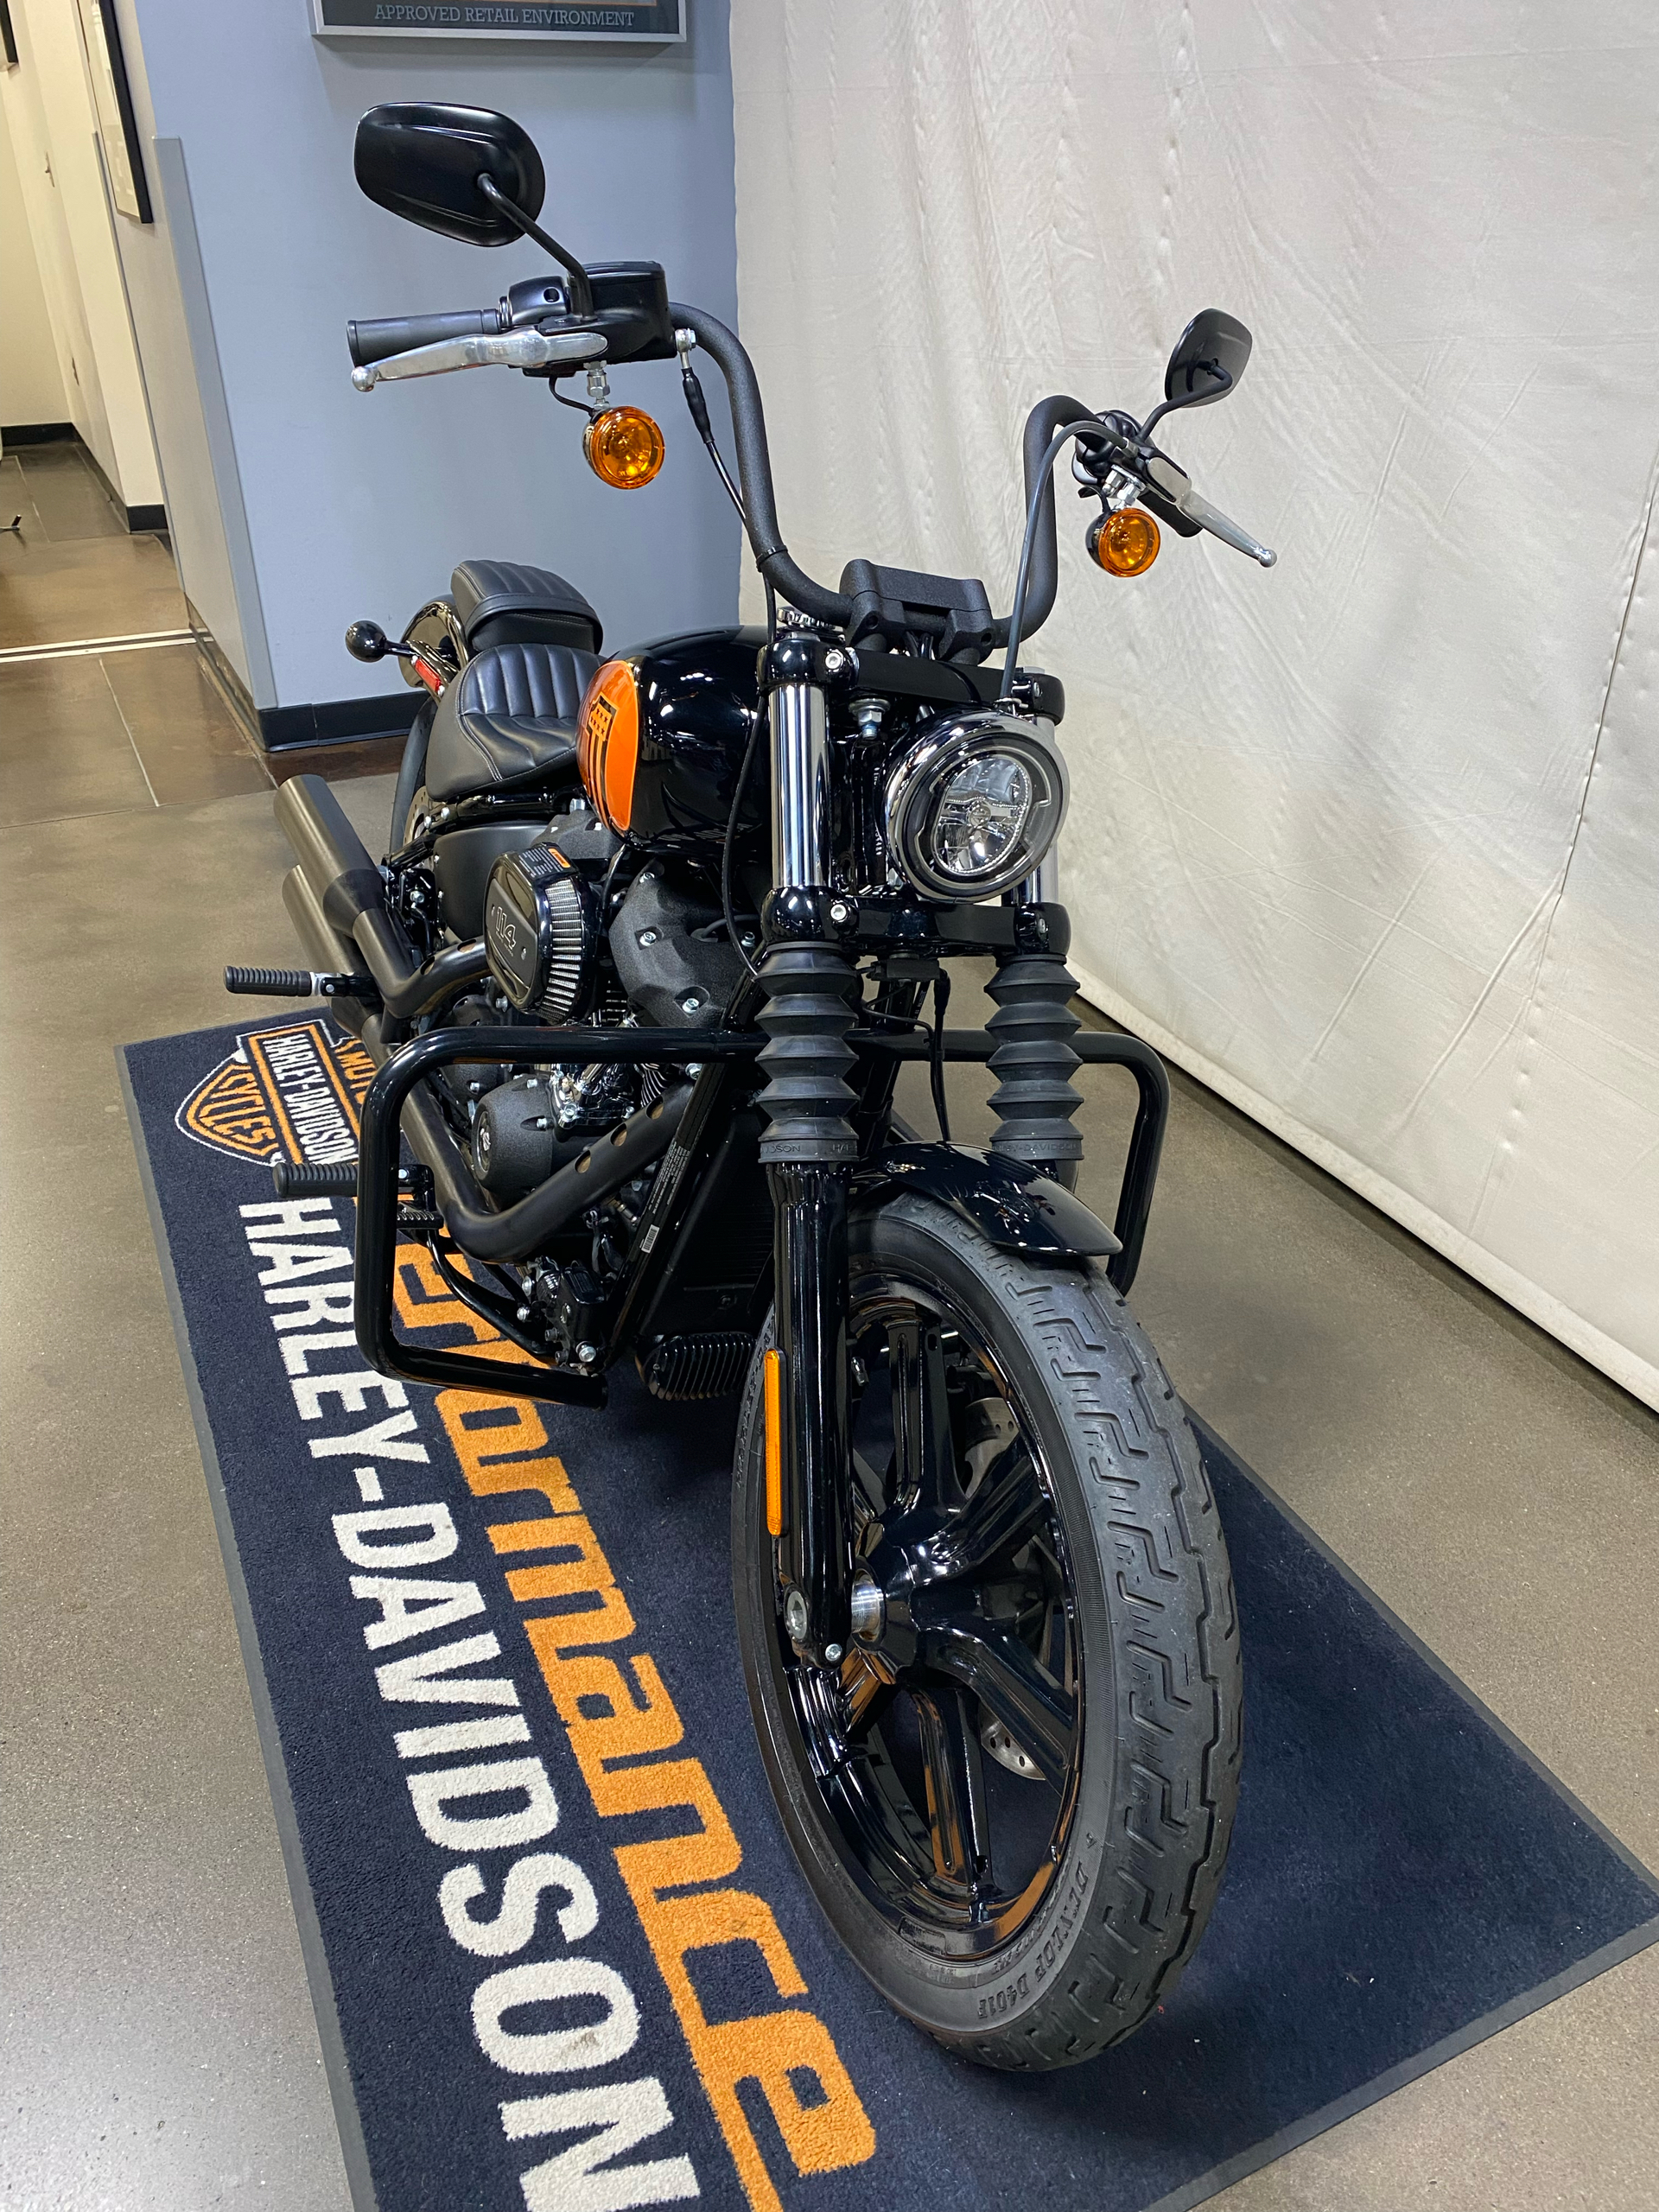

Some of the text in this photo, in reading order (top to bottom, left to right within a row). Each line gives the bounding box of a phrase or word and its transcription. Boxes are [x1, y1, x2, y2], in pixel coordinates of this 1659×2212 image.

[374, 5, 635, 28] APPROVED RETAIL ENVIRONMENT
[496, 906, 517, 950] 114
[200, 1071, 276, 1146] CYCLES
[263, 1035, 358, 1163] HARLEY-DAVIDSON
[238, 1197, 700, 2212] HARLEY-DAVIDSON
[353, 1194, 876, 2212] erormance
[977, 1974, 1028, 2019] D401F
